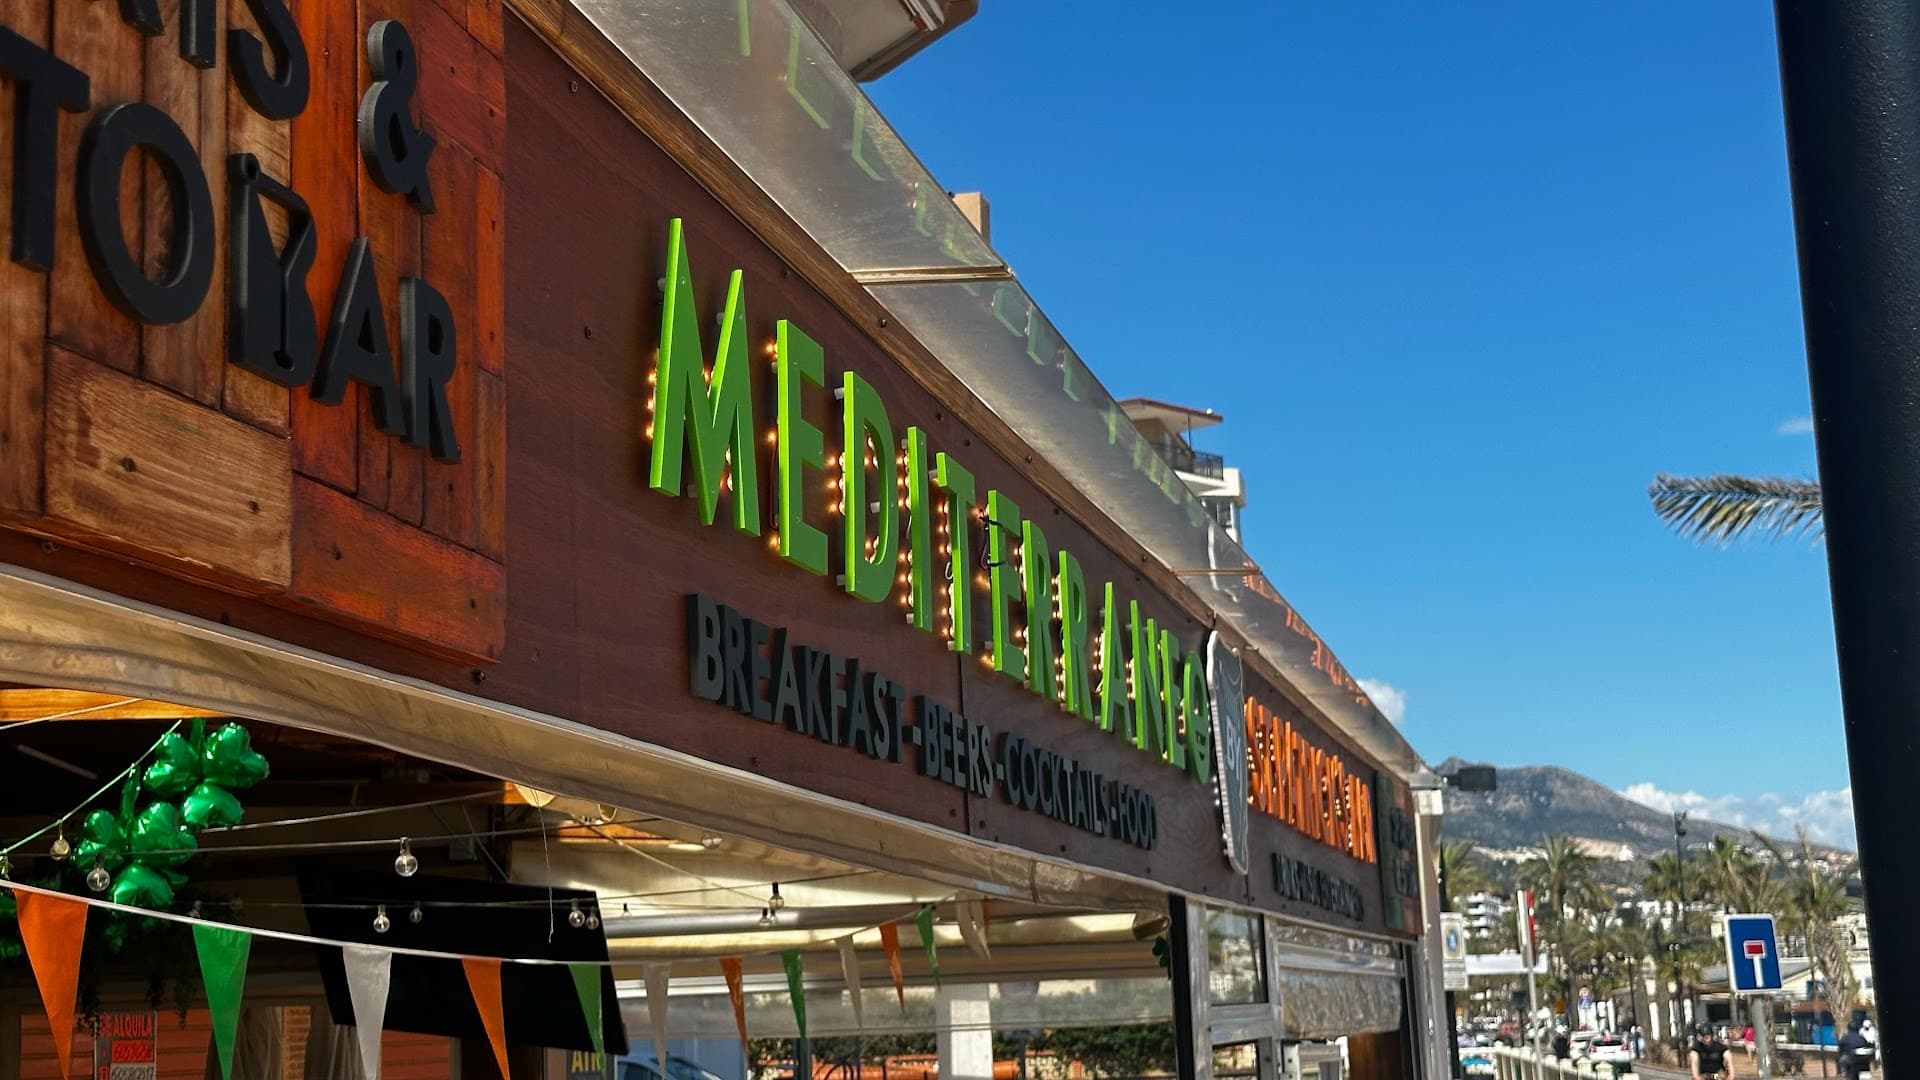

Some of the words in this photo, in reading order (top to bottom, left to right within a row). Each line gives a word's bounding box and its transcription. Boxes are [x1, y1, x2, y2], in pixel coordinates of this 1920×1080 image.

[358, 19, 437, 214] &
[649, 217, 1210, 785] MEDITERRANEO
[113, 1012, 152, 1038] ALQUILA
